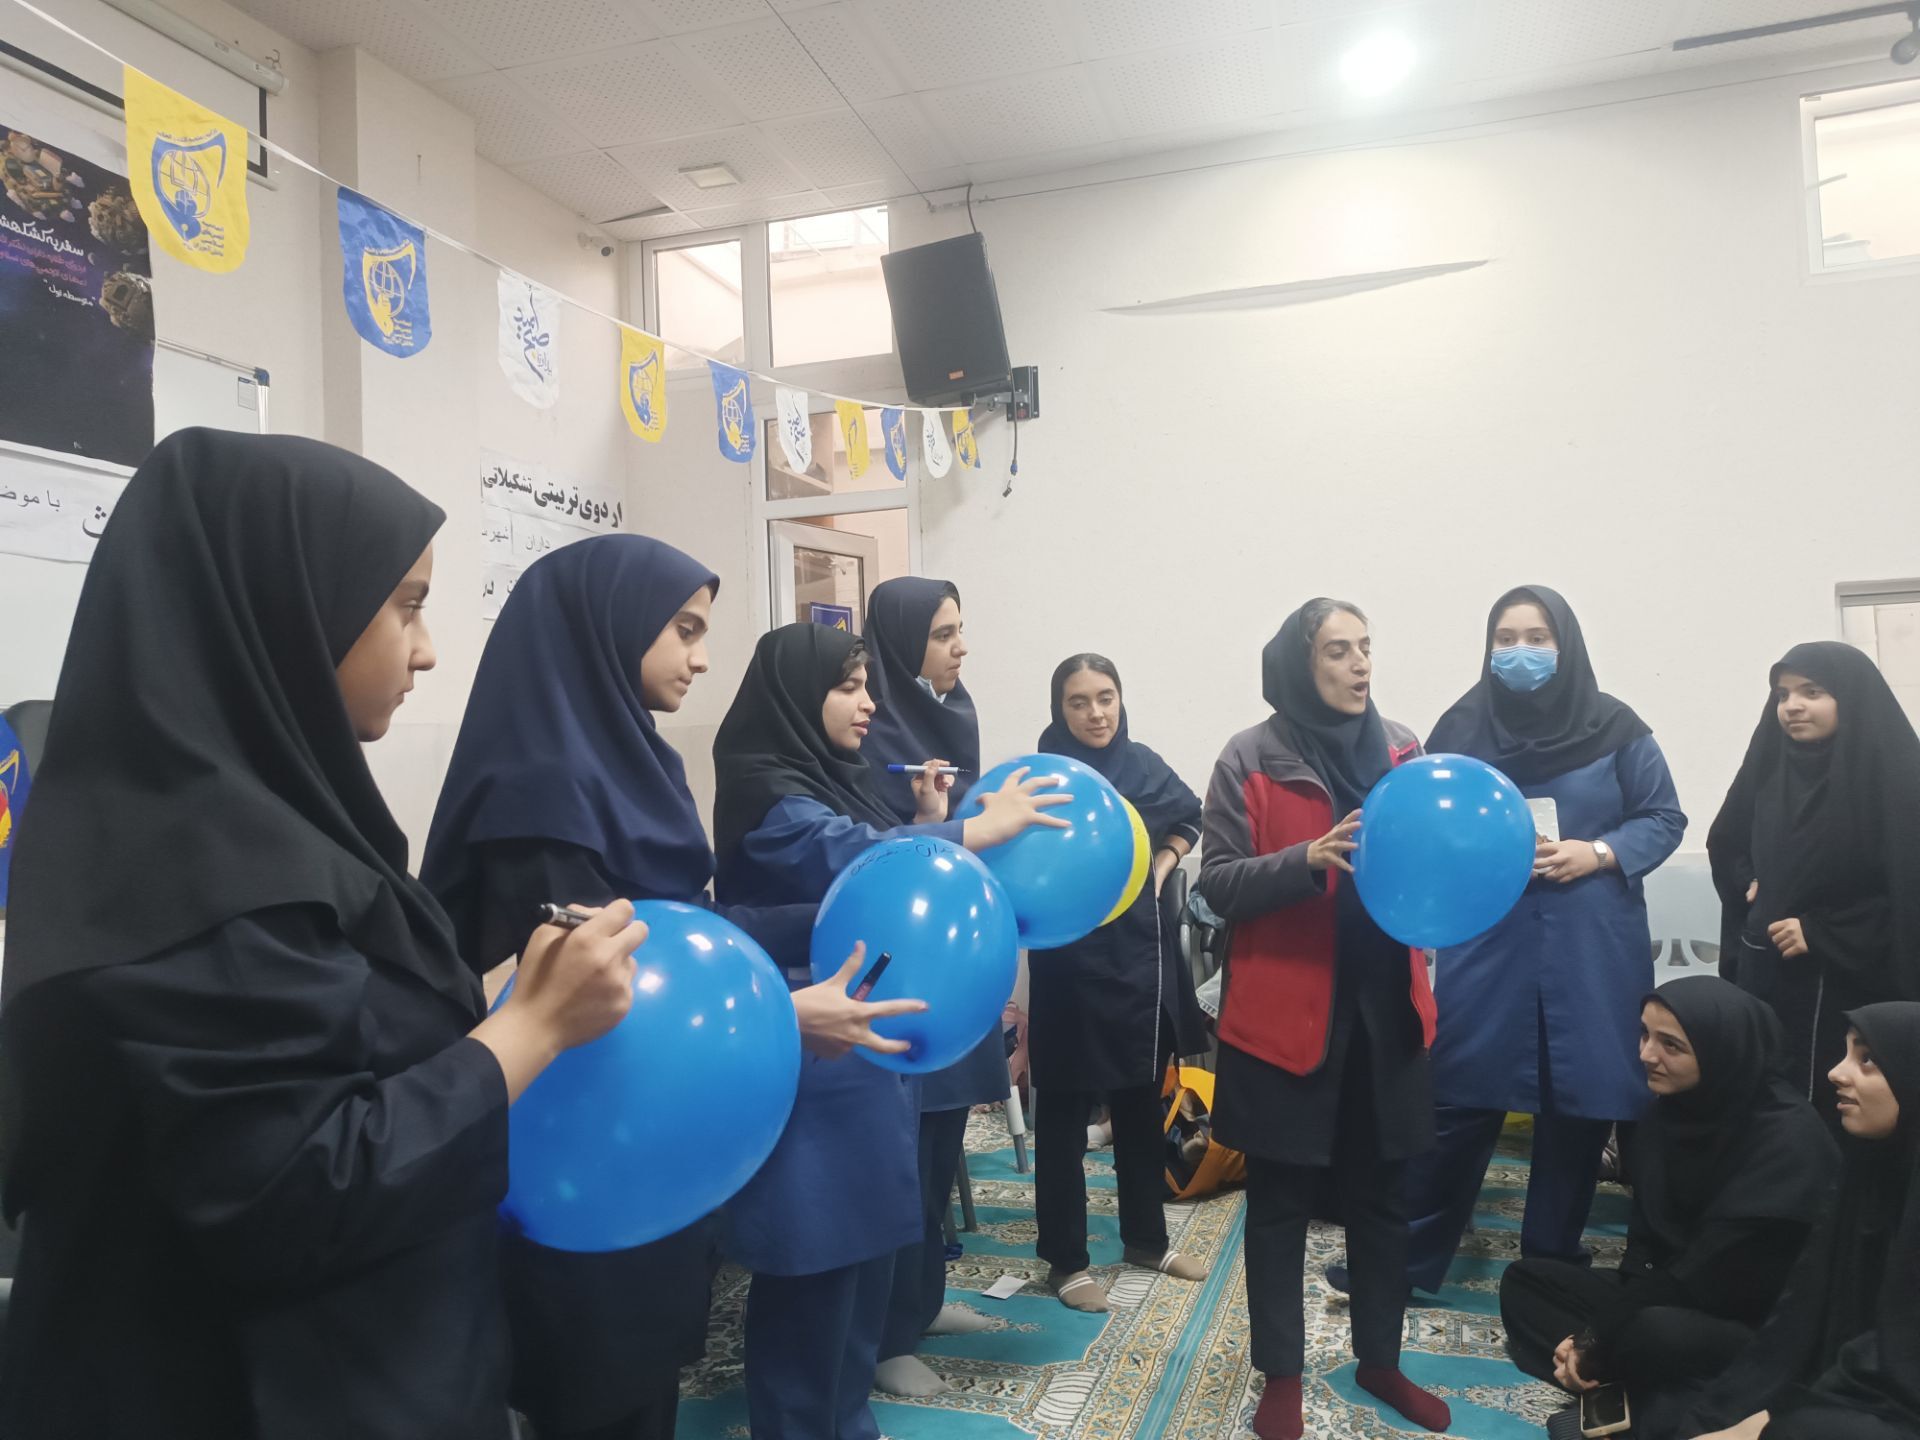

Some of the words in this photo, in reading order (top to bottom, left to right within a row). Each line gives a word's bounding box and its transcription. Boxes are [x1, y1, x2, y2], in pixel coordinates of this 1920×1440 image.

[482, 466, 533, 494] تشکیلاتی
[46, 489, 61, 512] با
[534, 482, 579, 515] تربیتی
[580, 499, 623, 528] اردوی
